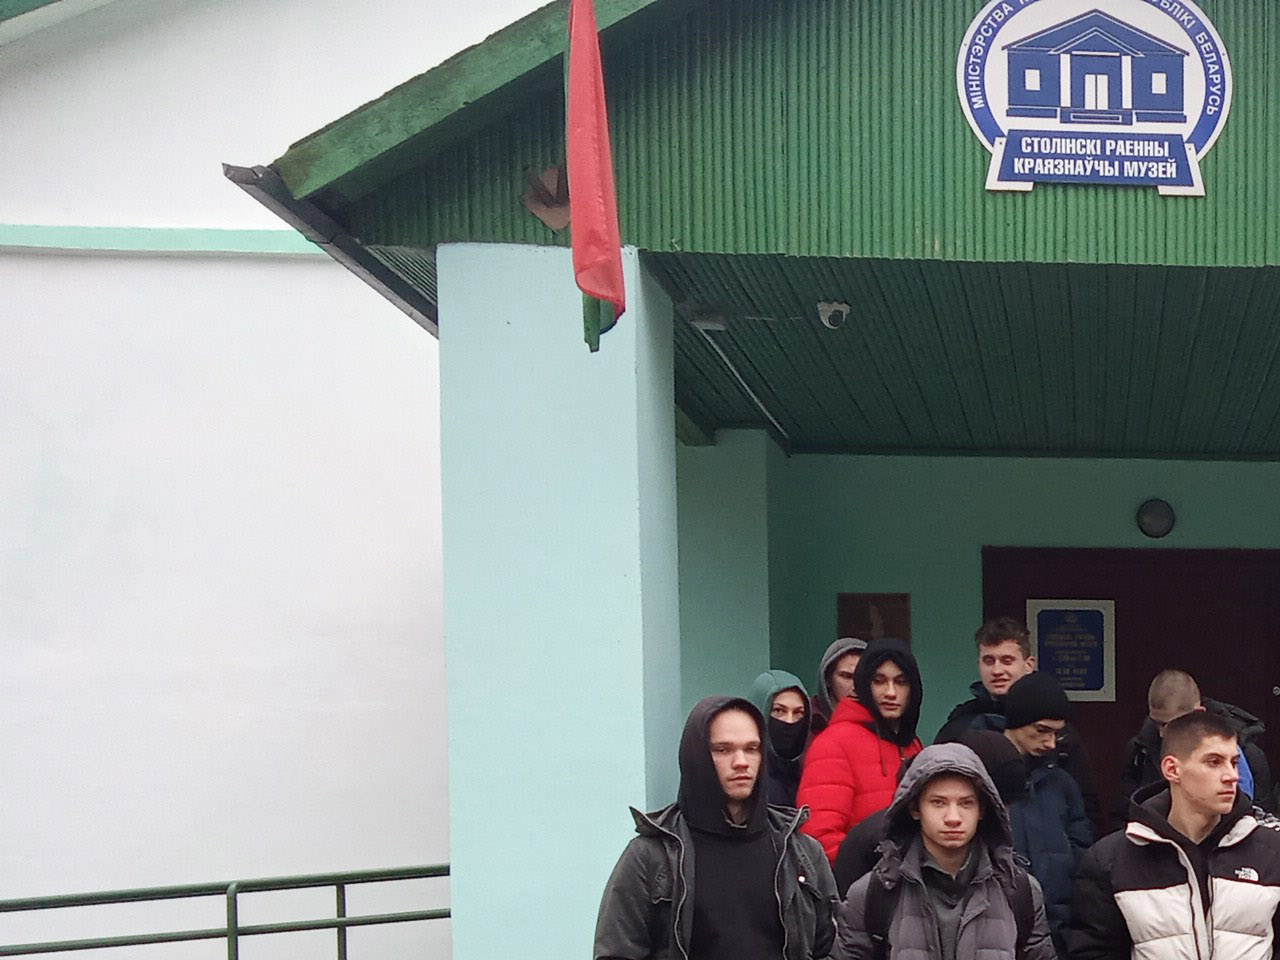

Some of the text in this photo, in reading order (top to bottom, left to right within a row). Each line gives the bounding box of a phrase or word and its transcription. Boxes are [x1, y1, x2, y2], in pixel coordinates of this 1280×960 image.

[968, 0, 1221, 115] МІНІСТЭРСТВА БЛІКІ БЕЛАРУСЬ
[1021, 136, 1101, 156] СТОЛІНСКІ
[1013, 156, 1178, 179] КРАЯЗНАЎЧЫ МУЗЕЙ
